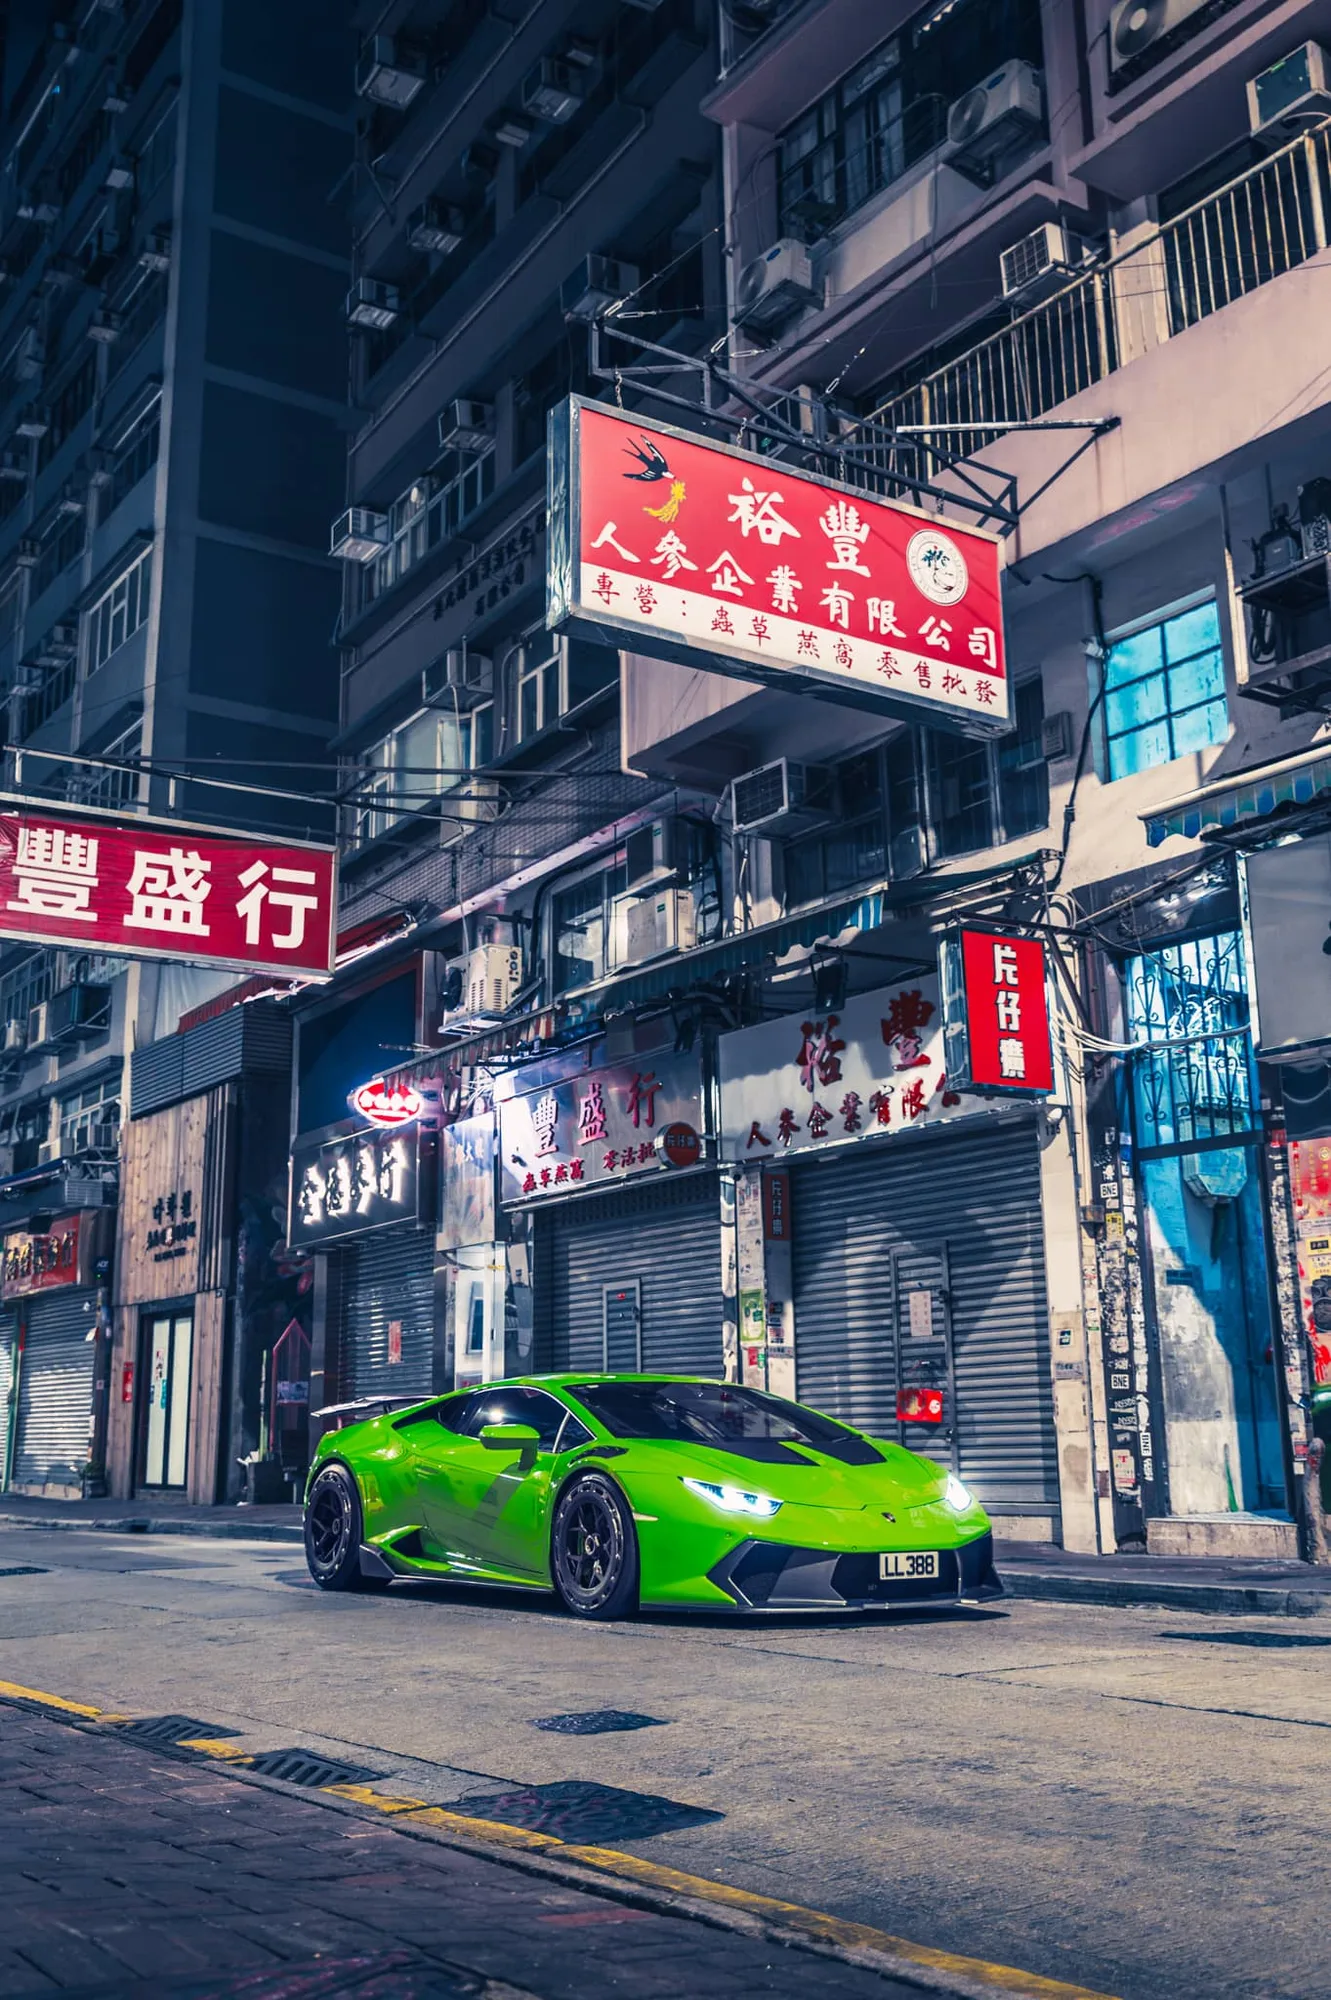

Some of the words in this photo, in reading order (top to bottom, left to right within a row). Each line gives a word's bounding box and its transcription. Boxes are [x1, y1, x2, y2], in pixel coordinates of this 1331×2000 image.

[727, 477, 871, 578] 裕豐
[590, 521, 997, 669] 人參企業有限公司
[6, 826, 318, 949] 豐盛行
[796, 990, 936, 1093] 裕豐
[533, 1072, 663, 1158] 豐盛行
[1113, 1375, 1128, 1387] BNE
